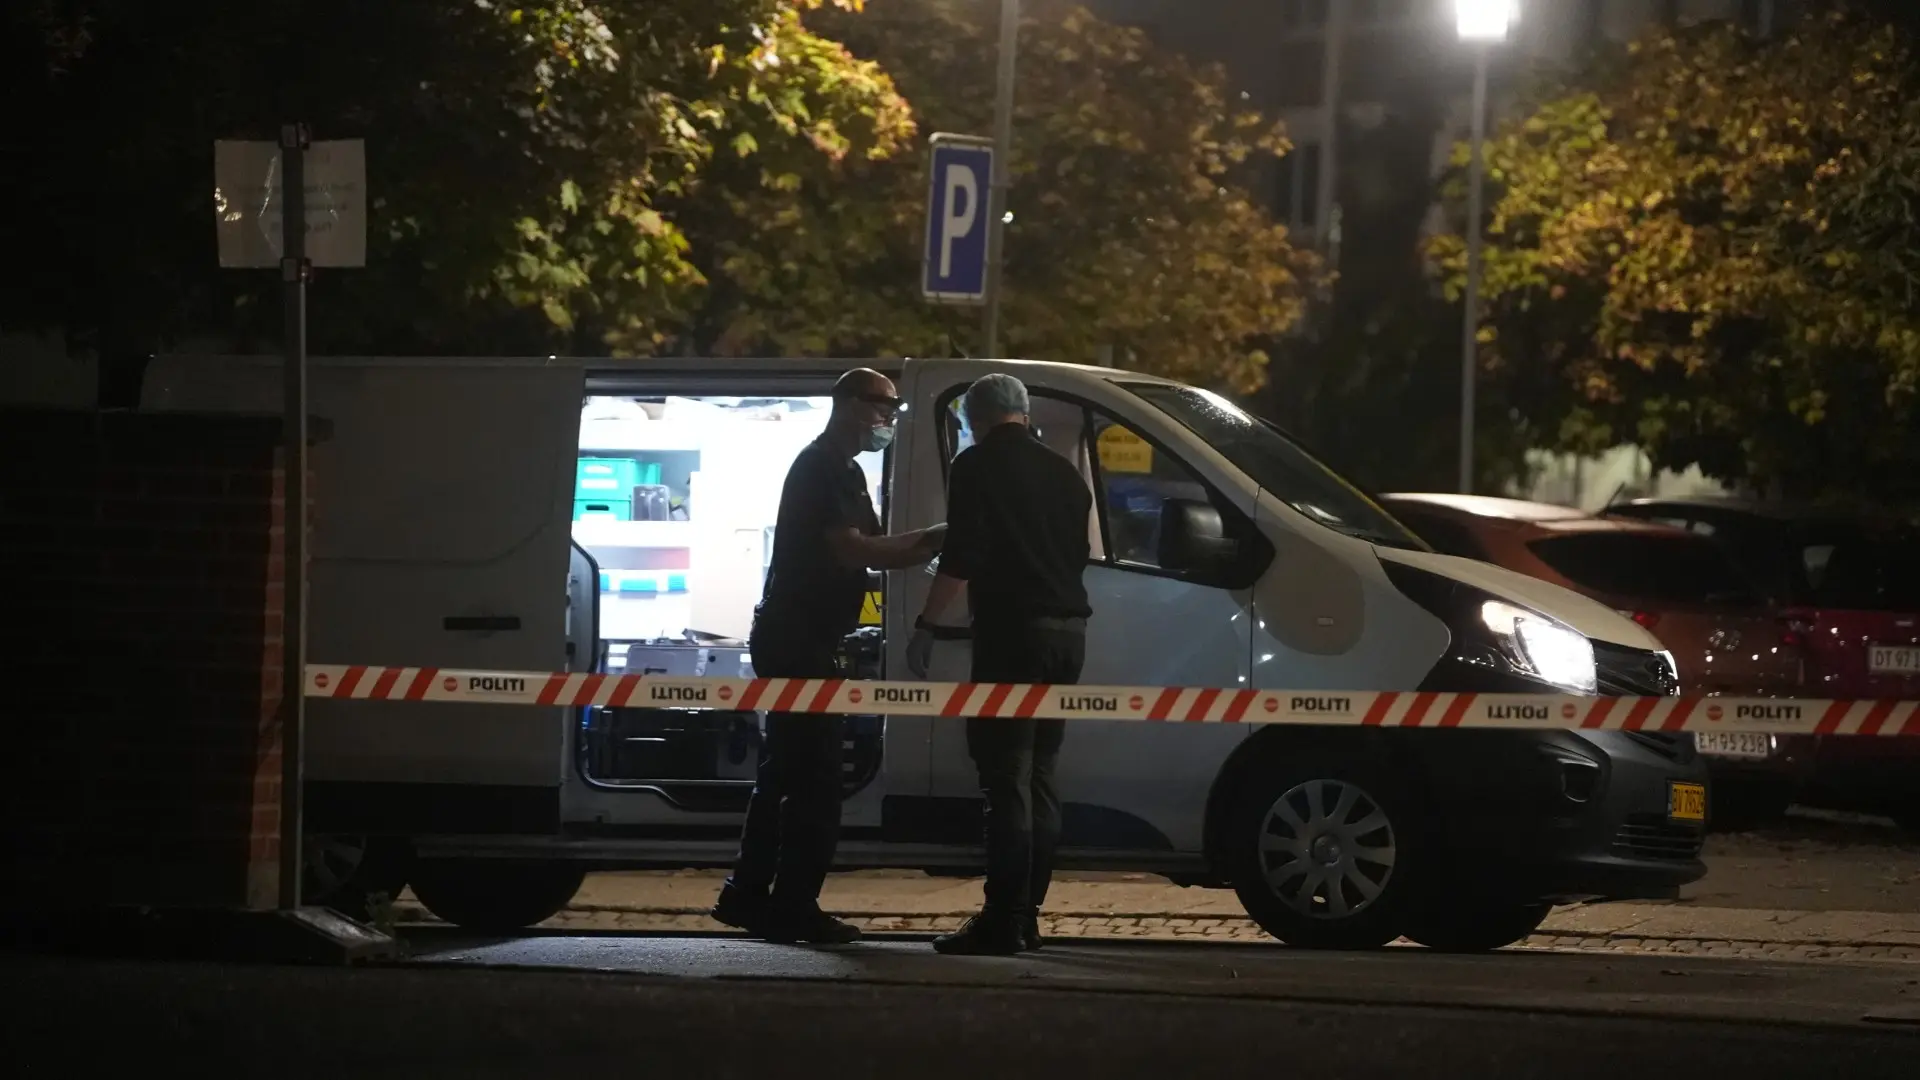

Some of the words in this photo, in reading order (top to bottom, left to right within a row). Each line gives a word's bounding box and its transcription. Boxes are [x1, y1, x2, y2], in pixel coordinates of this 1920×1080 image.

[939, 163, 978, 278] P
[469, 677, 525, 692] POLITI
[651, 687, 707, 701] POLITI
[874, 688, 930, 703] POLITI
[1060, 697, 1117, 711] POLITI
[1291, 697, 1350, 711] POLITI
[1487, 705, 1548, 720] POLITI
[1737, 705, 1801, 719] POLITI
